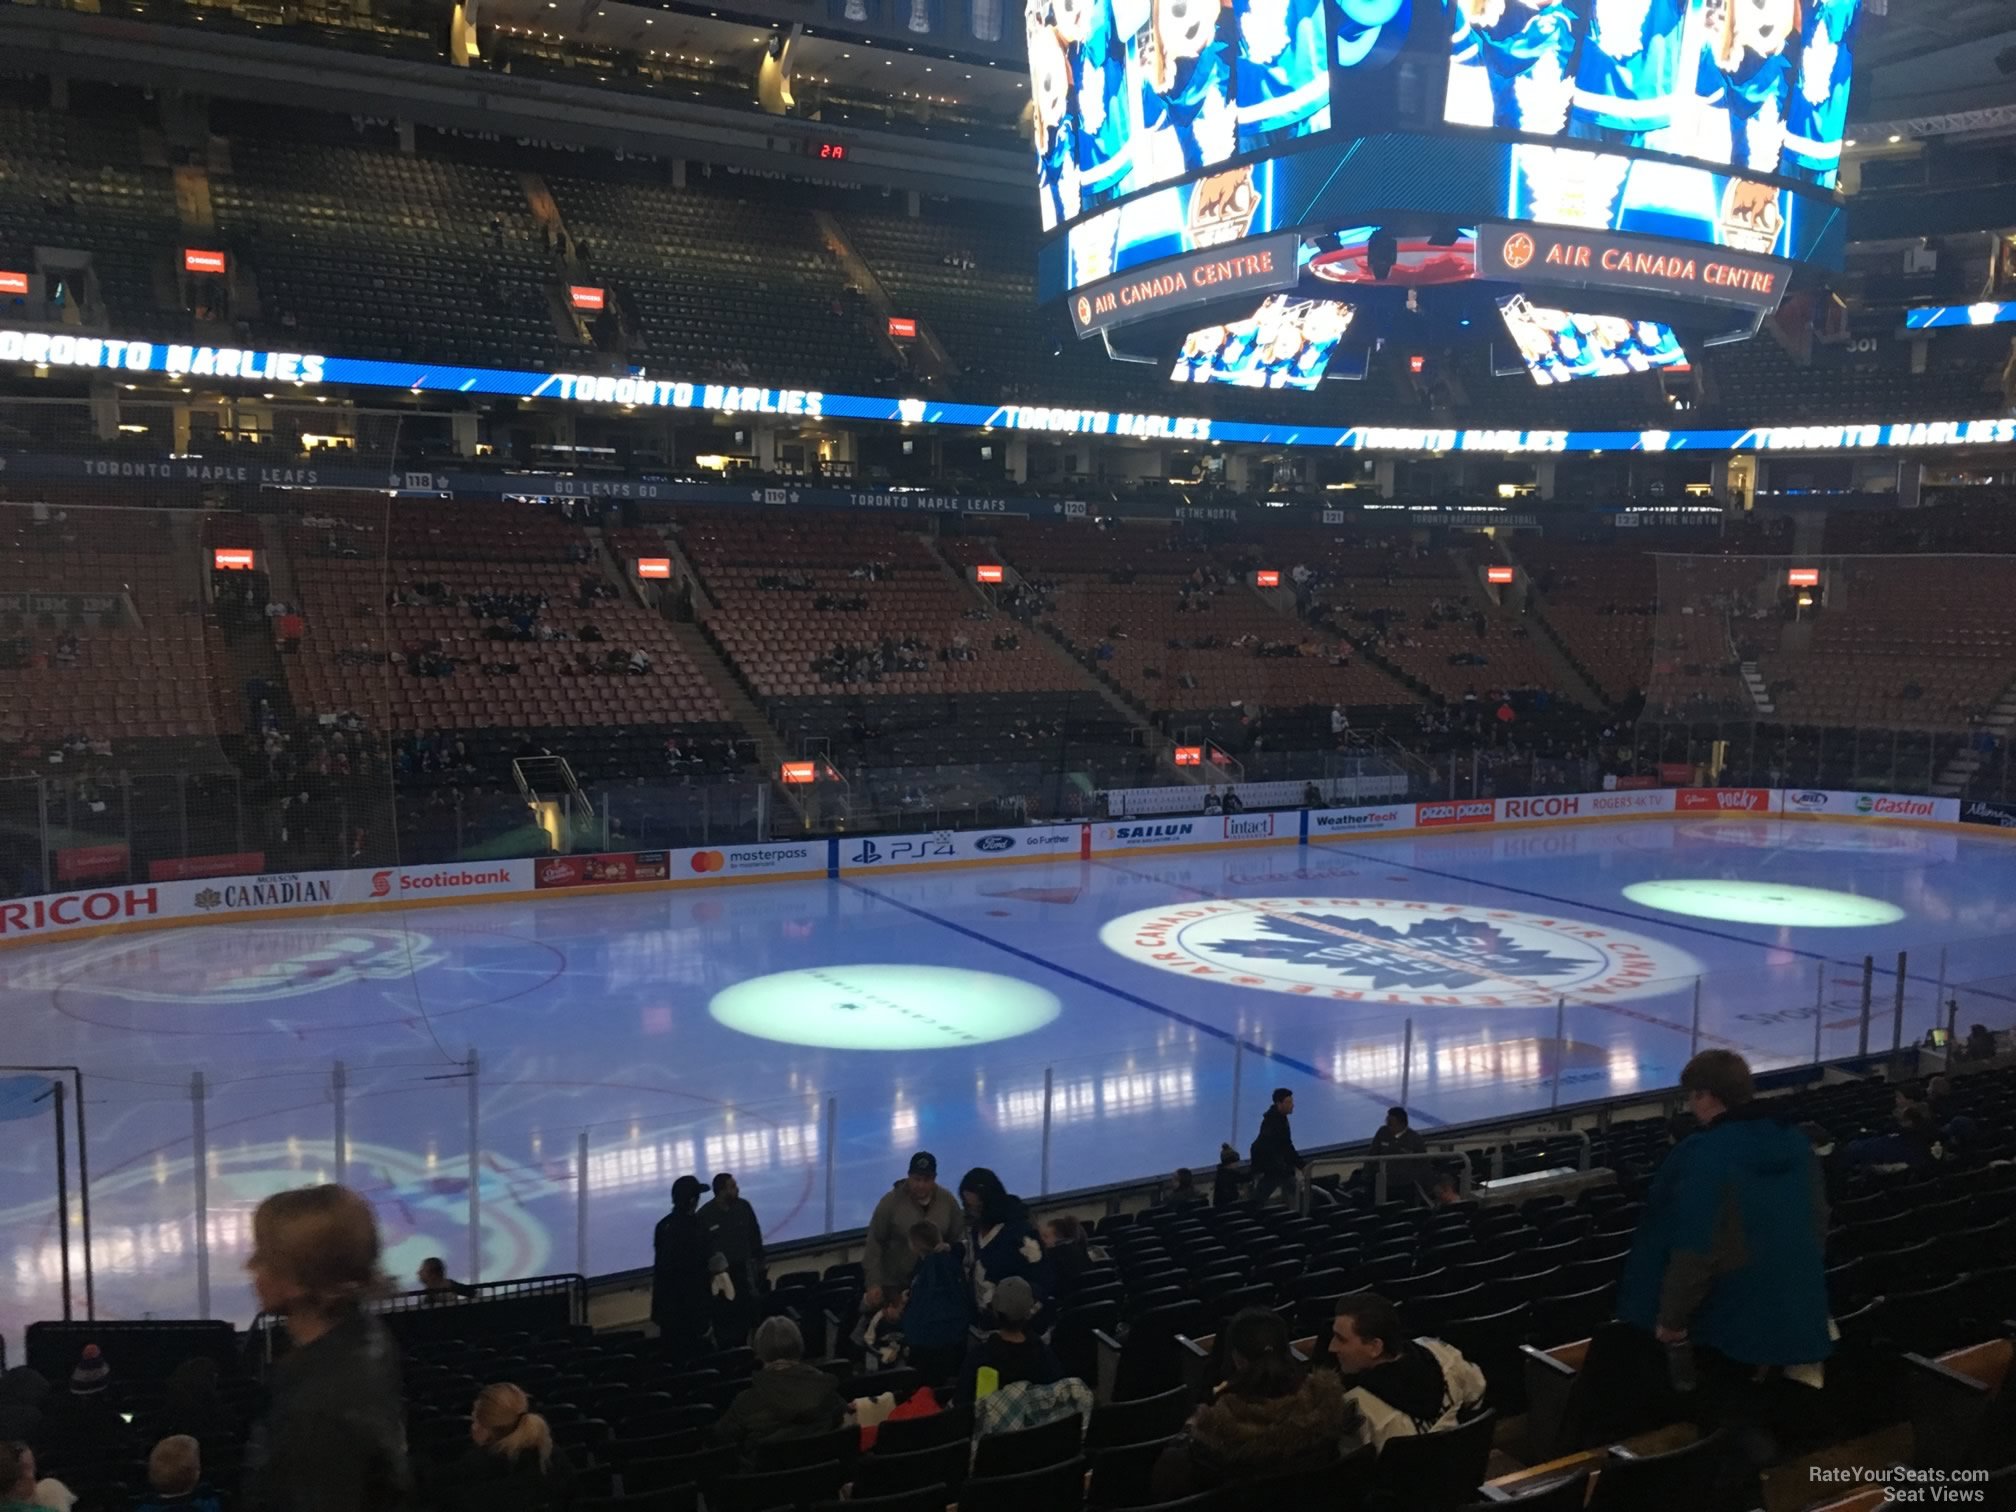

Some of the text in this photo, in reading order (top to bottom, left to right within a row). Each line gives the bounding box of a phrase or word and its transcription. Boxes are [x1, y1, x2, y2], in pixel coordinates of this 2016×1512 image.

[1545, 243, 1775, 294] AIR CANADA CENTRE
[1094, 251, 1274, 315] AIR CANADA CENTRE
[166, 344, 325, 382] MARLIES
[556, 374, 823, 416] TORONTO MARLIES
[1002, 405, 1212, 440] TORONTO MARLIES
[1353, 426, 1456, 450] TORONTO
[1751, 419, 2016, 450] TORONTO MARLIES
[85, 460, 318, 484] TORONTO MAPLE LEAFS
[406, 473, 432, 489] 118
[555, 481, 658, 498] GO LEAFS GO
[766, 490, 786, 504] 119
[850, 494, 1006, 512] TORONTO MAPLE LEAFS
[1065, 502, 1086, 516] 120
[1189, 507, 1204, 519] THE
[1505, 797, 1579, 818] RICOH
[1592, 796, 1632, 810] ROGERS
[1649, 795, 1663, 806] TV
[1874, 797, 1935, 816] Castrol
[1317, 811, 1397, 826] WeatherTech
[1419, 803, 1492, 823] pizza pizza
[1116, 823, 1193, 839] SAILUN
[1228, 819, 1269, 835] intact
[890, 839, 956, 859] PS4
[982, 836, 1011, 851] Ford
[1027, 834, 1070, 846] Go Further
[730, 847, 807, 866] masterpass
[400, 869, 511, 890] Scotiabank
[225, 880, 331, 908] CANADIAN
[0, 887, 158, 933] RICOH
[1134, 899, 1466, 975] AIR CANADA CENTRE
[1524, 919, 1660, 996] AIR CANADA
